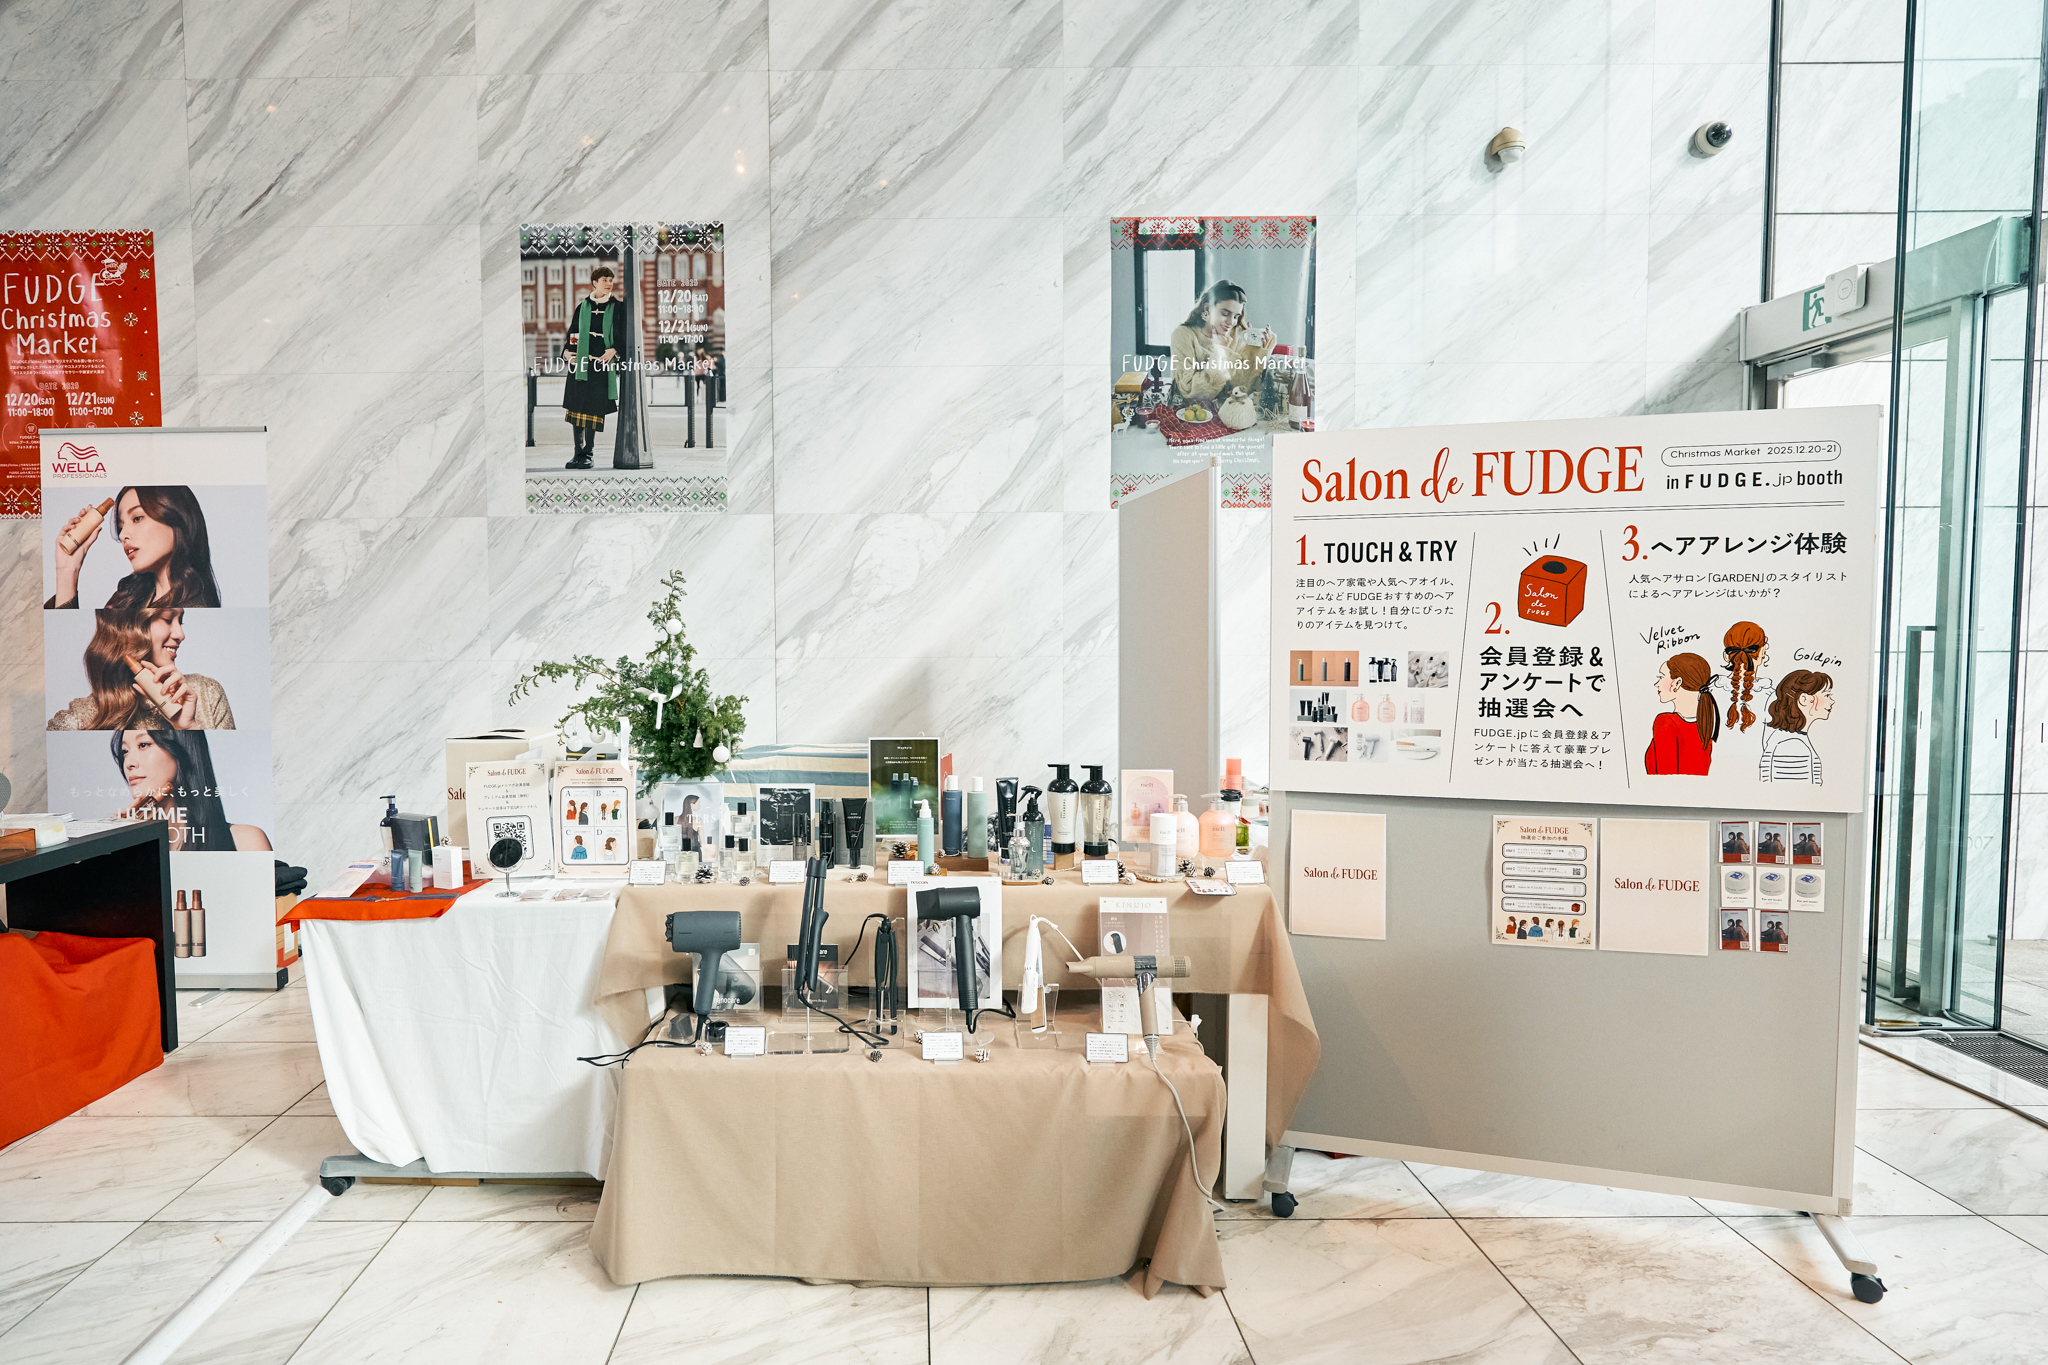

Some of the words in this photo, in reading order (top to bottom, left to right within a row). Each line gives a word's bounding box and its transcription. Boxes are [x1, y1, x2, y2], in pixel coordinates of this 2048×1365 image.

[4, 273, 105, 305] FUDGE
[657, 279, 676, 287] DATE
[1, 306, 111, 330] Christmas
[17, 331, 98, 355] Market
[533, 356, 589, 374] FUDGE
[593, 358, 660, 372] Christmas
[665, 357, 715, 371] Market
[1122, 354, 1179, 372] FUDGE
[1183, 356, 1250, 370] Christmas
[1255, 355, 1305, 370] Market
[39, 382, 58, 390] DATE
[1670, 448, 1721, 458] Christmas
[1724, 447, 1760, 457] Market
[1767, 444, 1836, 455] 2025.12.20-21
[52, 462, 106, 473] WELLA
[1301, 457, 1410, 503] Salon
[1420, 447, 1463, 503] de
[1471, 445, 1645, 497] FUDGE
[1666, 475, 1679, 489] in
[1797, 470, 1843, 486] booth
[1621, 524, 1648, 561] 3.
[1651, 532, 1848, 555] ヘアアレンジ体験
[1296, 534, 1316, 566] 1.
[1323, 541, 1393, 563] TOUCH
[1416, 540, 1458, 562] TRY
[1296, 577, 1454, 588] 注目のヘア家電や人気ヘアオイル、
[1628, 571, 1848, 584] 人気ヘアサロン「GARDEN」のスタイリスト
[1524, 583, 1558, 600] Salon
[1628, 588, 1781, 598] によるヘアアレンジはいかが？
[1296, 605, 1454, 616] アイテムをお試し！自分にぴった
[1531, 599, 1547, 608] de
[1484, 601, 1510, 635] 2.
[1527, 608, 1551, 617] FUDGE
[1297, 620, 1409, 630] りのアイテムを見つけて。
[1639, 624, 1685, 645] Velvet
[1656, 631, 1701, 655] Ribbon
[1793, 648, 1842, 667] Goldpin
[1479, 672, 1606, 693] アンケートで
[1478, 697, 1584, 719] 抽選会へ
[1474, 742, 1611, 755] ンケートに答えて豪華プレ
[1473, 756, 1604, 770] ゼントが当たる抽選会へ！
[507, 768, 526, 776] FUDGE
[70, 785, 249, 798] もっとなめらかに、もっと美しく
[1519, 825, 1537, 834] Salon
[1545, 826, 1569, 834] FUDGE
[1303, 866, 1329, 878] Salon
[1330, 866, 1340, 880] de
[1341, 868, 1378, 880] FUDGE
[1614, 877, 1643, 890] Salon
[1645, 877, 1657, 891] de
[1658, 880, 1700, 892] FUDGE
